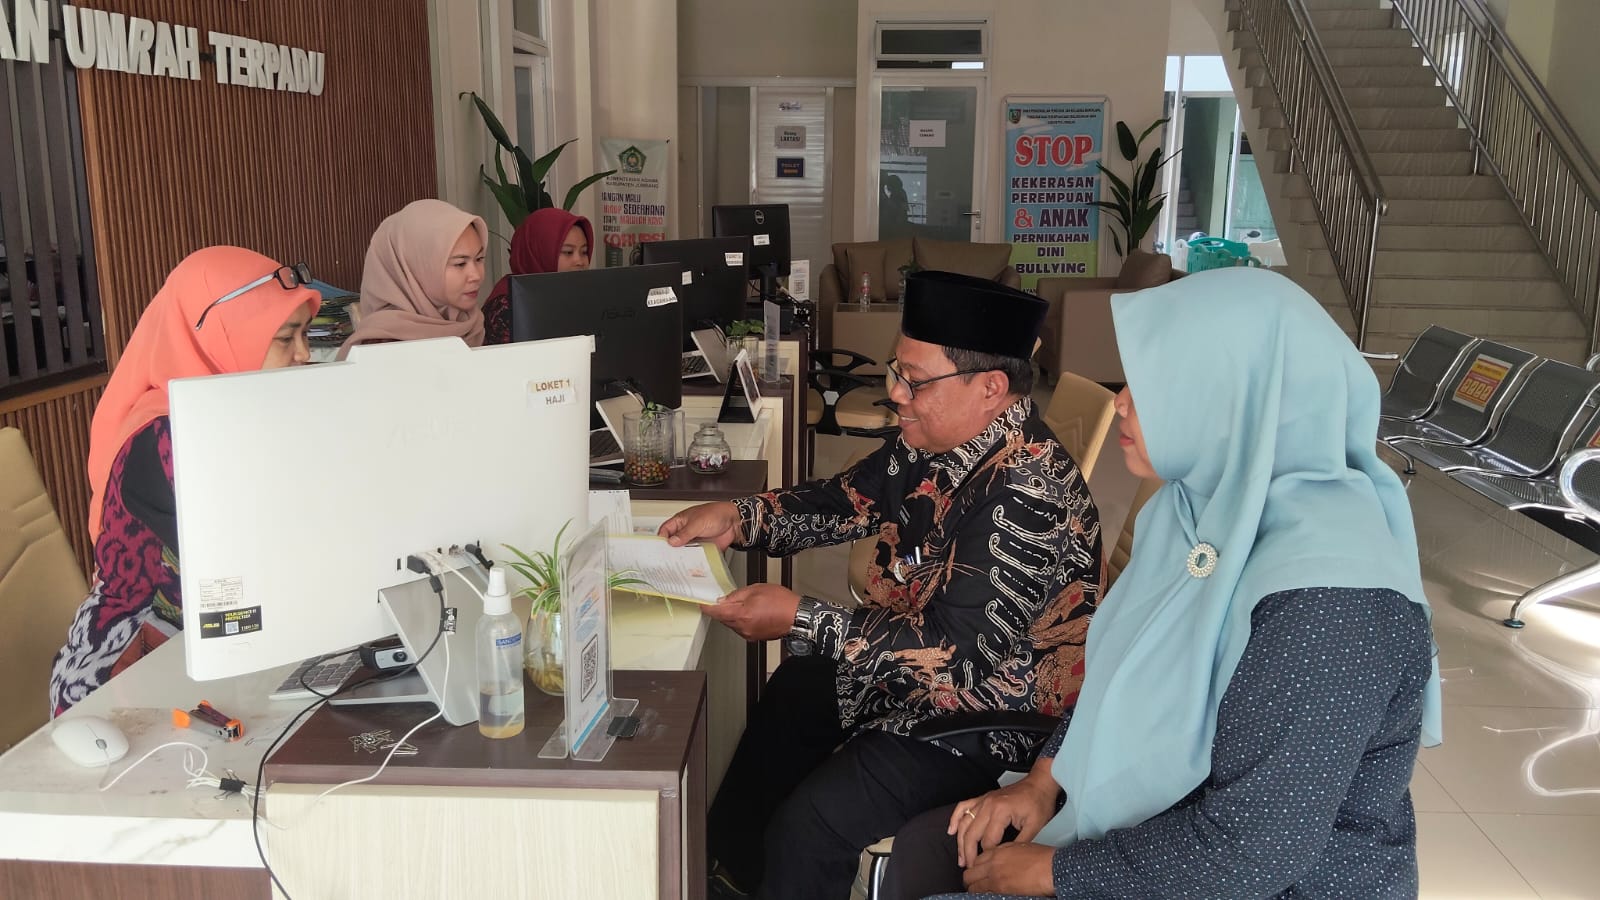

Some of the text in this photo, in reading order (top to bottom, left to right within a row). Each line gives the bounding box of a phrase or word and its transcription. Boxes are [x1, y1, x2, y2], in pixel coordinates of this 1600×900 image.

[62, 4, 201, 81] UMRAH
[208, 30, 325, 97] TERPADU
[1014, 134, 1094, 168] STOP
[1011, 176, 1095, 189] KEKERASAN
[1011, 191, 1094, 204] PEREMPUAN
[623, 203, 665, 216] SEDERHANA
[1014, 208, 1089, 229] & ANAK
[1013, 233, 1090, 243] PERNIKAHAN
[1037, 246, 1065, 257] DINI
[1015, 263, 1086, 274] BULLYING
[535, 378, 570, 392] LOKET 1
[545, 394, 565, 405] HAJI
